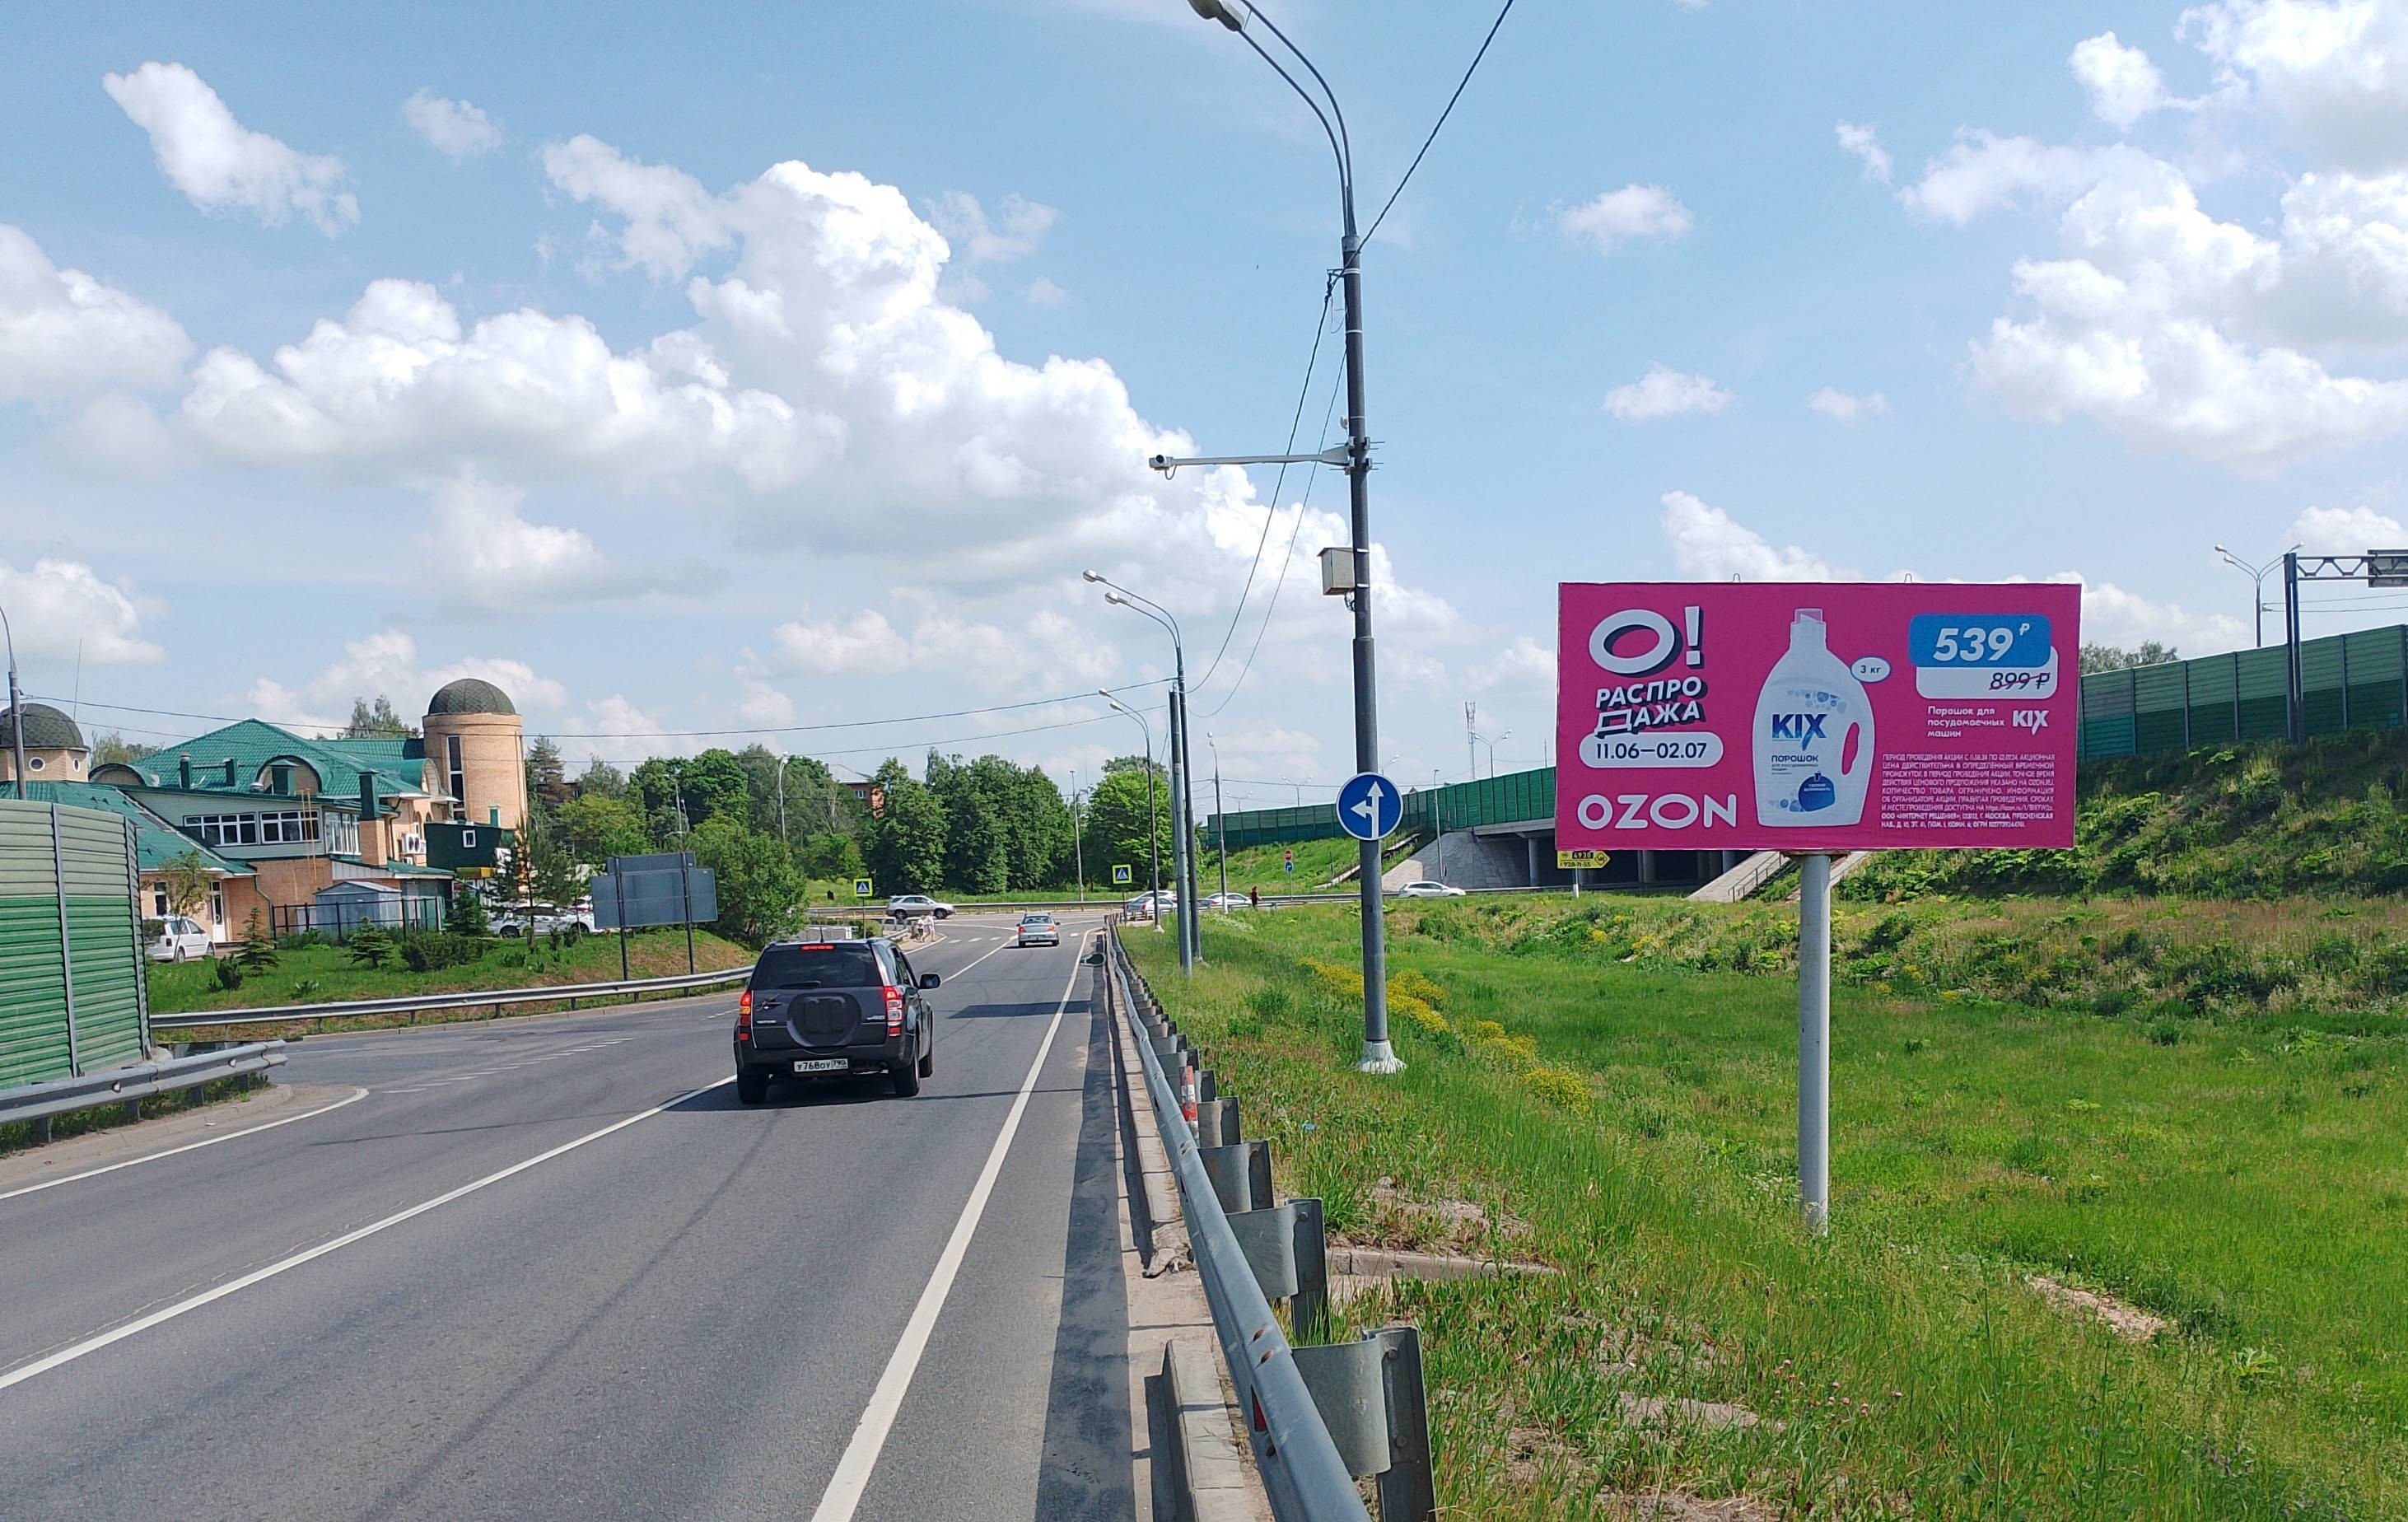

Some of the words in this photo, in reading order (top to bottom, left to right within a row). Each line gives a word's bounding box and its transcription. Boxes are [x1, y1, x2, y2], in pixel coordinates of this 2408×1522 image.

[1933, 628, 2014, 661] 539
[1860, 665, 1866, 673] 3
[1990, 672, 2030, 689] 899
[1596, 676, 1702, 708] РАСПРО
[1594, 700, 1701, 735] ДАЖА
[1927, 706, 1974, 717] Порошок
[1976, 707, 1995, 716] для
[1927, 719, 2005, 727] посудомоечных
[2012, 710, 2049, 735] KIX
[1771, 713, 1827, 751] KIX
[1577, 793, 1737, 829] OZON
